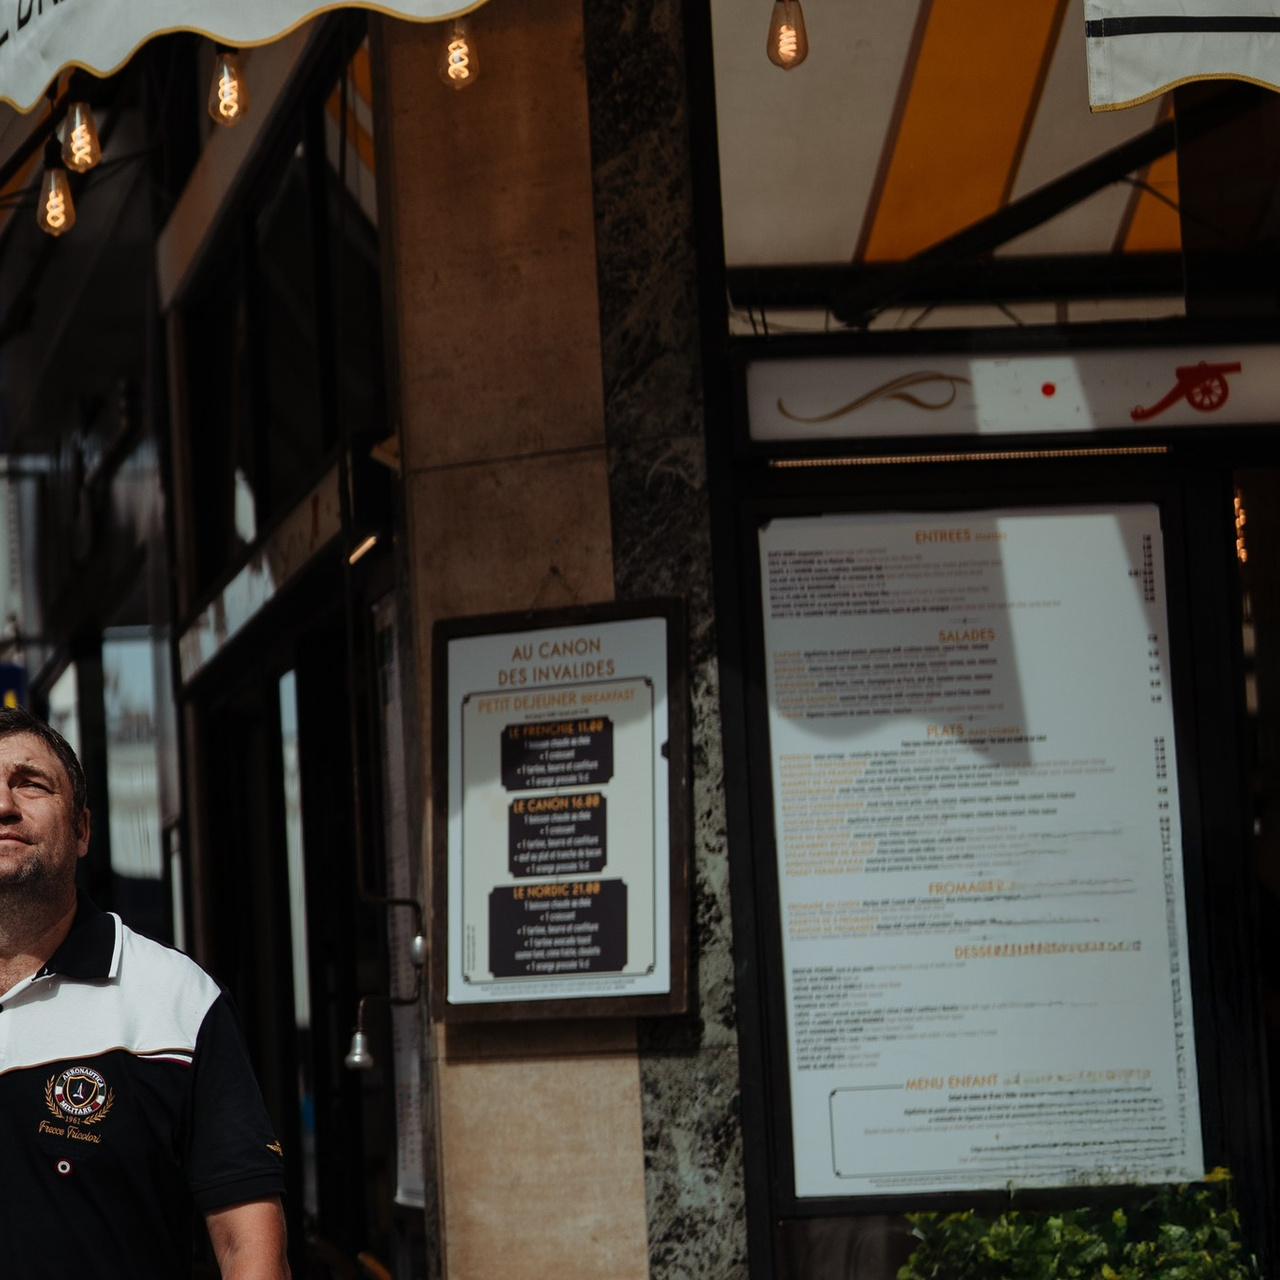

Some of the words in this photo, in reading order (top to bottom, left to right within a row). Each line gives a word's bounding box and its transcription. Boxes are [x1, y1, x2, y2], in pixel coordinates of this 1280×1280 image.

[939, 627, 995, 643] SALADES
[512, 643, 533, 661] AU
[538, 637, 601, 659] CANON
[498, 668, 527, 686] DES
[532, 659, 615, 683] INVALIDES
[477, 697, 510, 714] PETIT
[512, 801, 526, 814] LE
[526, 796, 569, 812] CANON
[513, 887, 525, 900] LE
[62, 1067, 104, 1087] AERONAUTICA
[905, 1075, 945, 1091] MENU
[948, 1073, 999, 1090] ENFANT
[59, 1100, 93, 1115] MILITARE
[64, 1115, 81, 1125] 1961
[38, 1119, 65, 1136] Frecce
[66, 1125, 102, 1144] Tricolori
